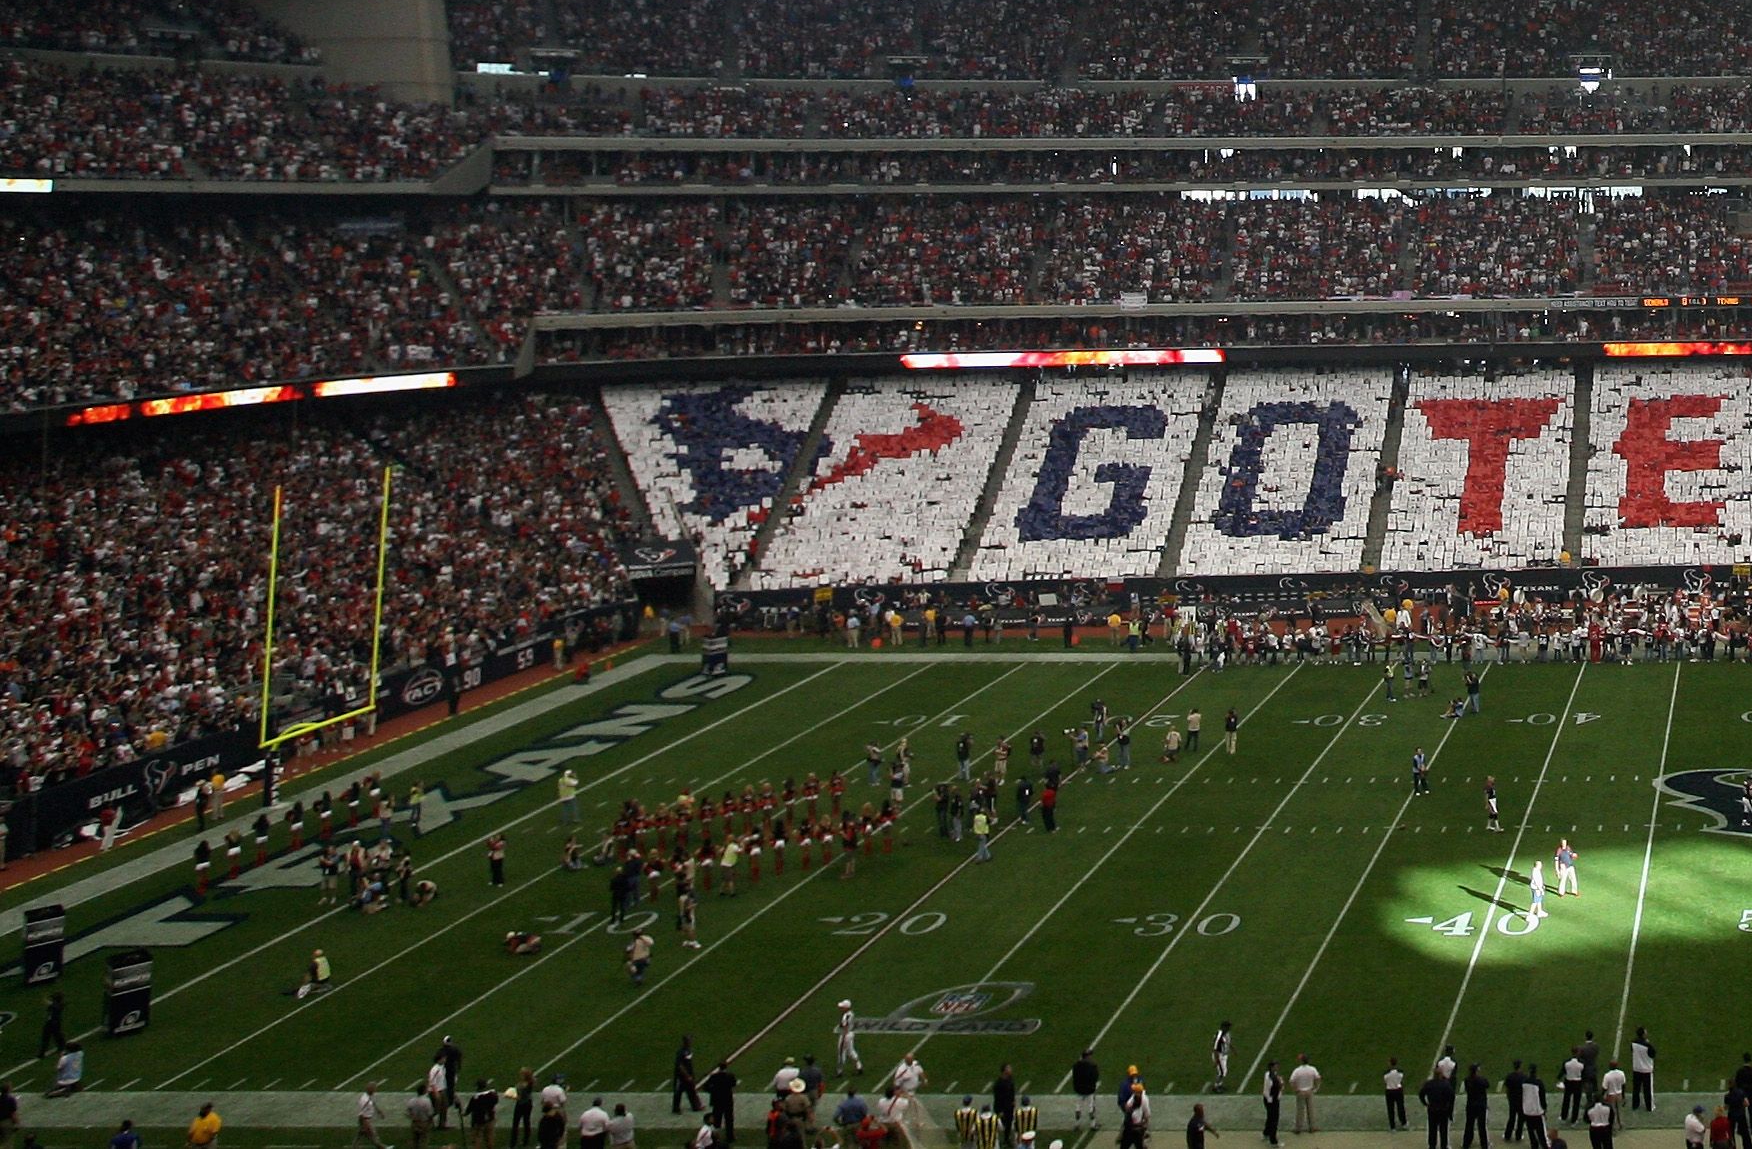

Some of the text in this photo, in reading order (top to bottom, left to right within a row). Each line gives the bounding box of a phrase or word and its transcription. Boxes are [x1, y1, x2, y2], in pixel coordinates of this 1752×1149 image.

[1014, 399, 1361, 542] GO
[181, 754, 221, 776] PEN
[88, 784, 138, 810] BULL
[830, 912, 948, 938] 20
[1133, 912, 1242, 938] 30
[1431, 911, 1540, 938] 40
